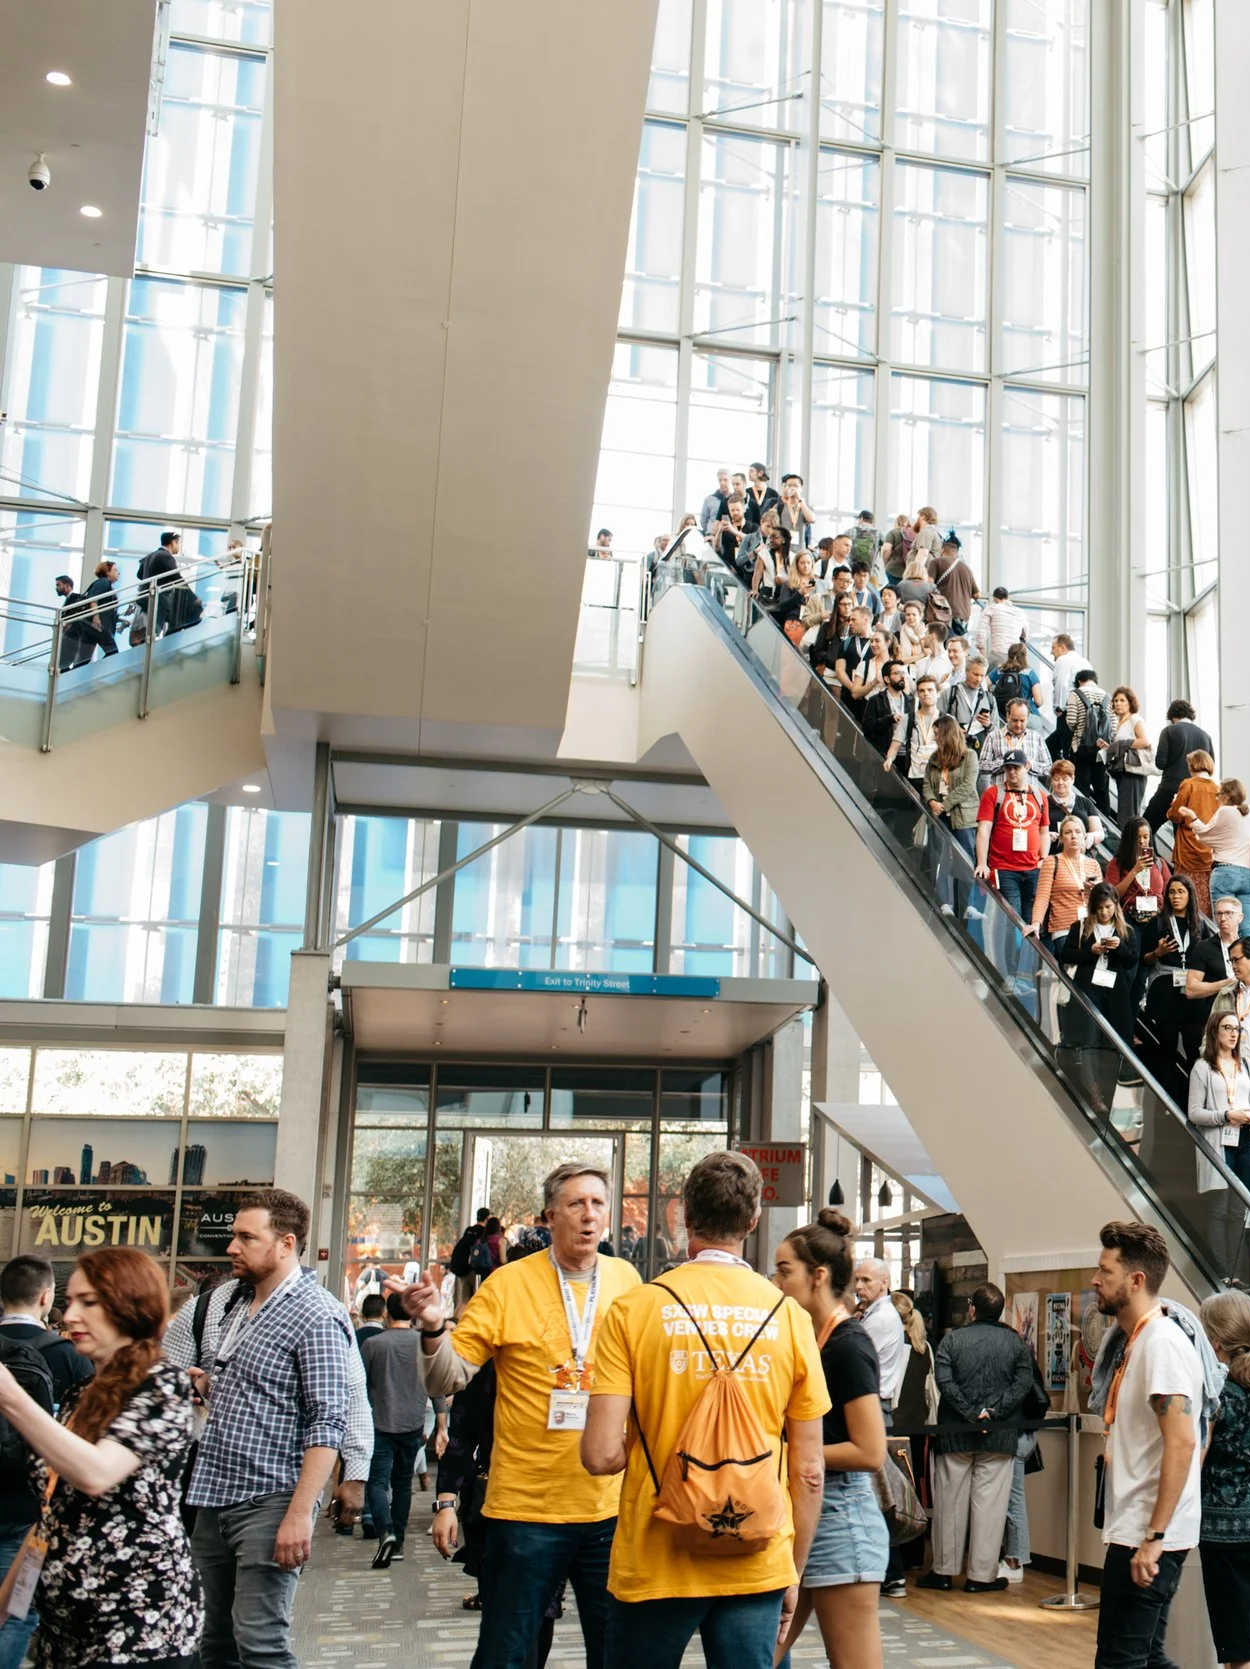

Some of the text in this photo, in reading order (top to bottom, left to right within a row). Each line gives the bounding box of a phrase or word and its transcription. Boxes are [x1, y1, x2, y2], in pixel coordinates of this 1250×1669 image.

[544, 976, 630, 989] Exit to Trinity Street
[761, 1168, 779, 1182] FE
[762, 1186, 780, 1201] O.
[29, 1200, 113, 1218] Welcome to
[200, 1213, 235, 1223] AUS
[34, 1215, 162, 1246] AUSTIN
[661, 1304, 709, 1320] SXSW
[663, 1321, 779, 1341] VENUES CREW
[691, 1350, 772, 1375] TEXAS
